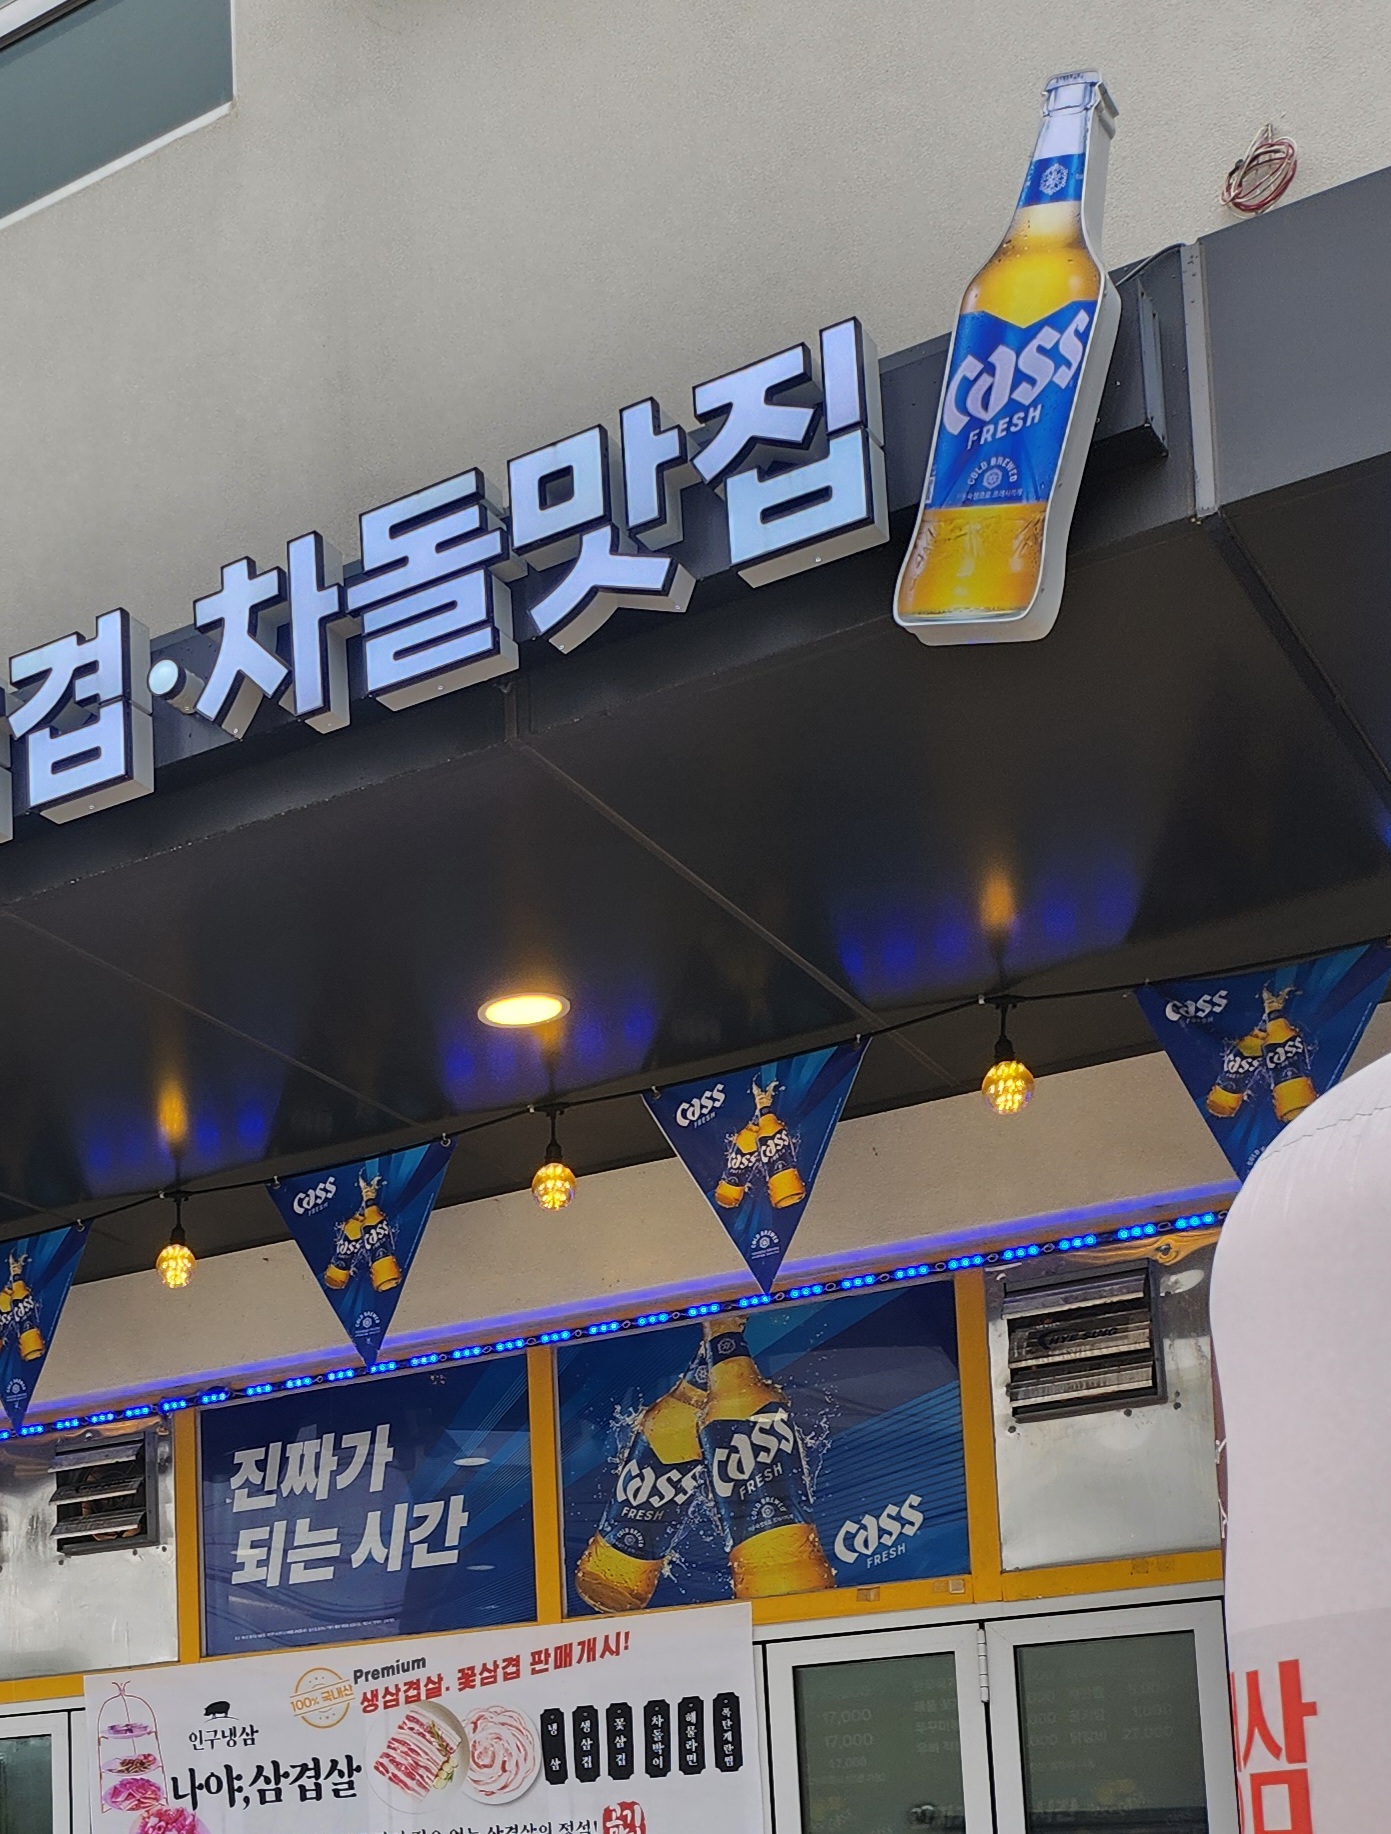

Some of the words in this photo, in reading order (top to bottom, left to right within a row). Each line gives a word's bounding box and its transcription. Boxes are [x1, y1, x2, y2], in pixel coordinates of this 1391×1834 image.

[966, 403, 1043, 450] FRESH
[967, 460, 989, 486] COLD
[989, 455, 1019, 483] BREWED
[229, 1422, 395, 1514] 진짜가
[738, 1461, 784, 1501] FRESH
[620, 1505, 665, 1521] FRESH
[230, 1516, 340, 1588] 되는
[349, 1493, 471, 1575] 시간
[866, 1542, 907, 1569] FRESH
[353, 1655, 427, 1685] Premium
[457, 1654, 521, 1693] 꽃삼겹
[529, 1631, 631, 1676] 판매개시!
[290, 1693, 320, 1713] 100%
[321, 1683, 356, 1705] 국내산
[188, 1724, 260, 1751] 인구냉삼
